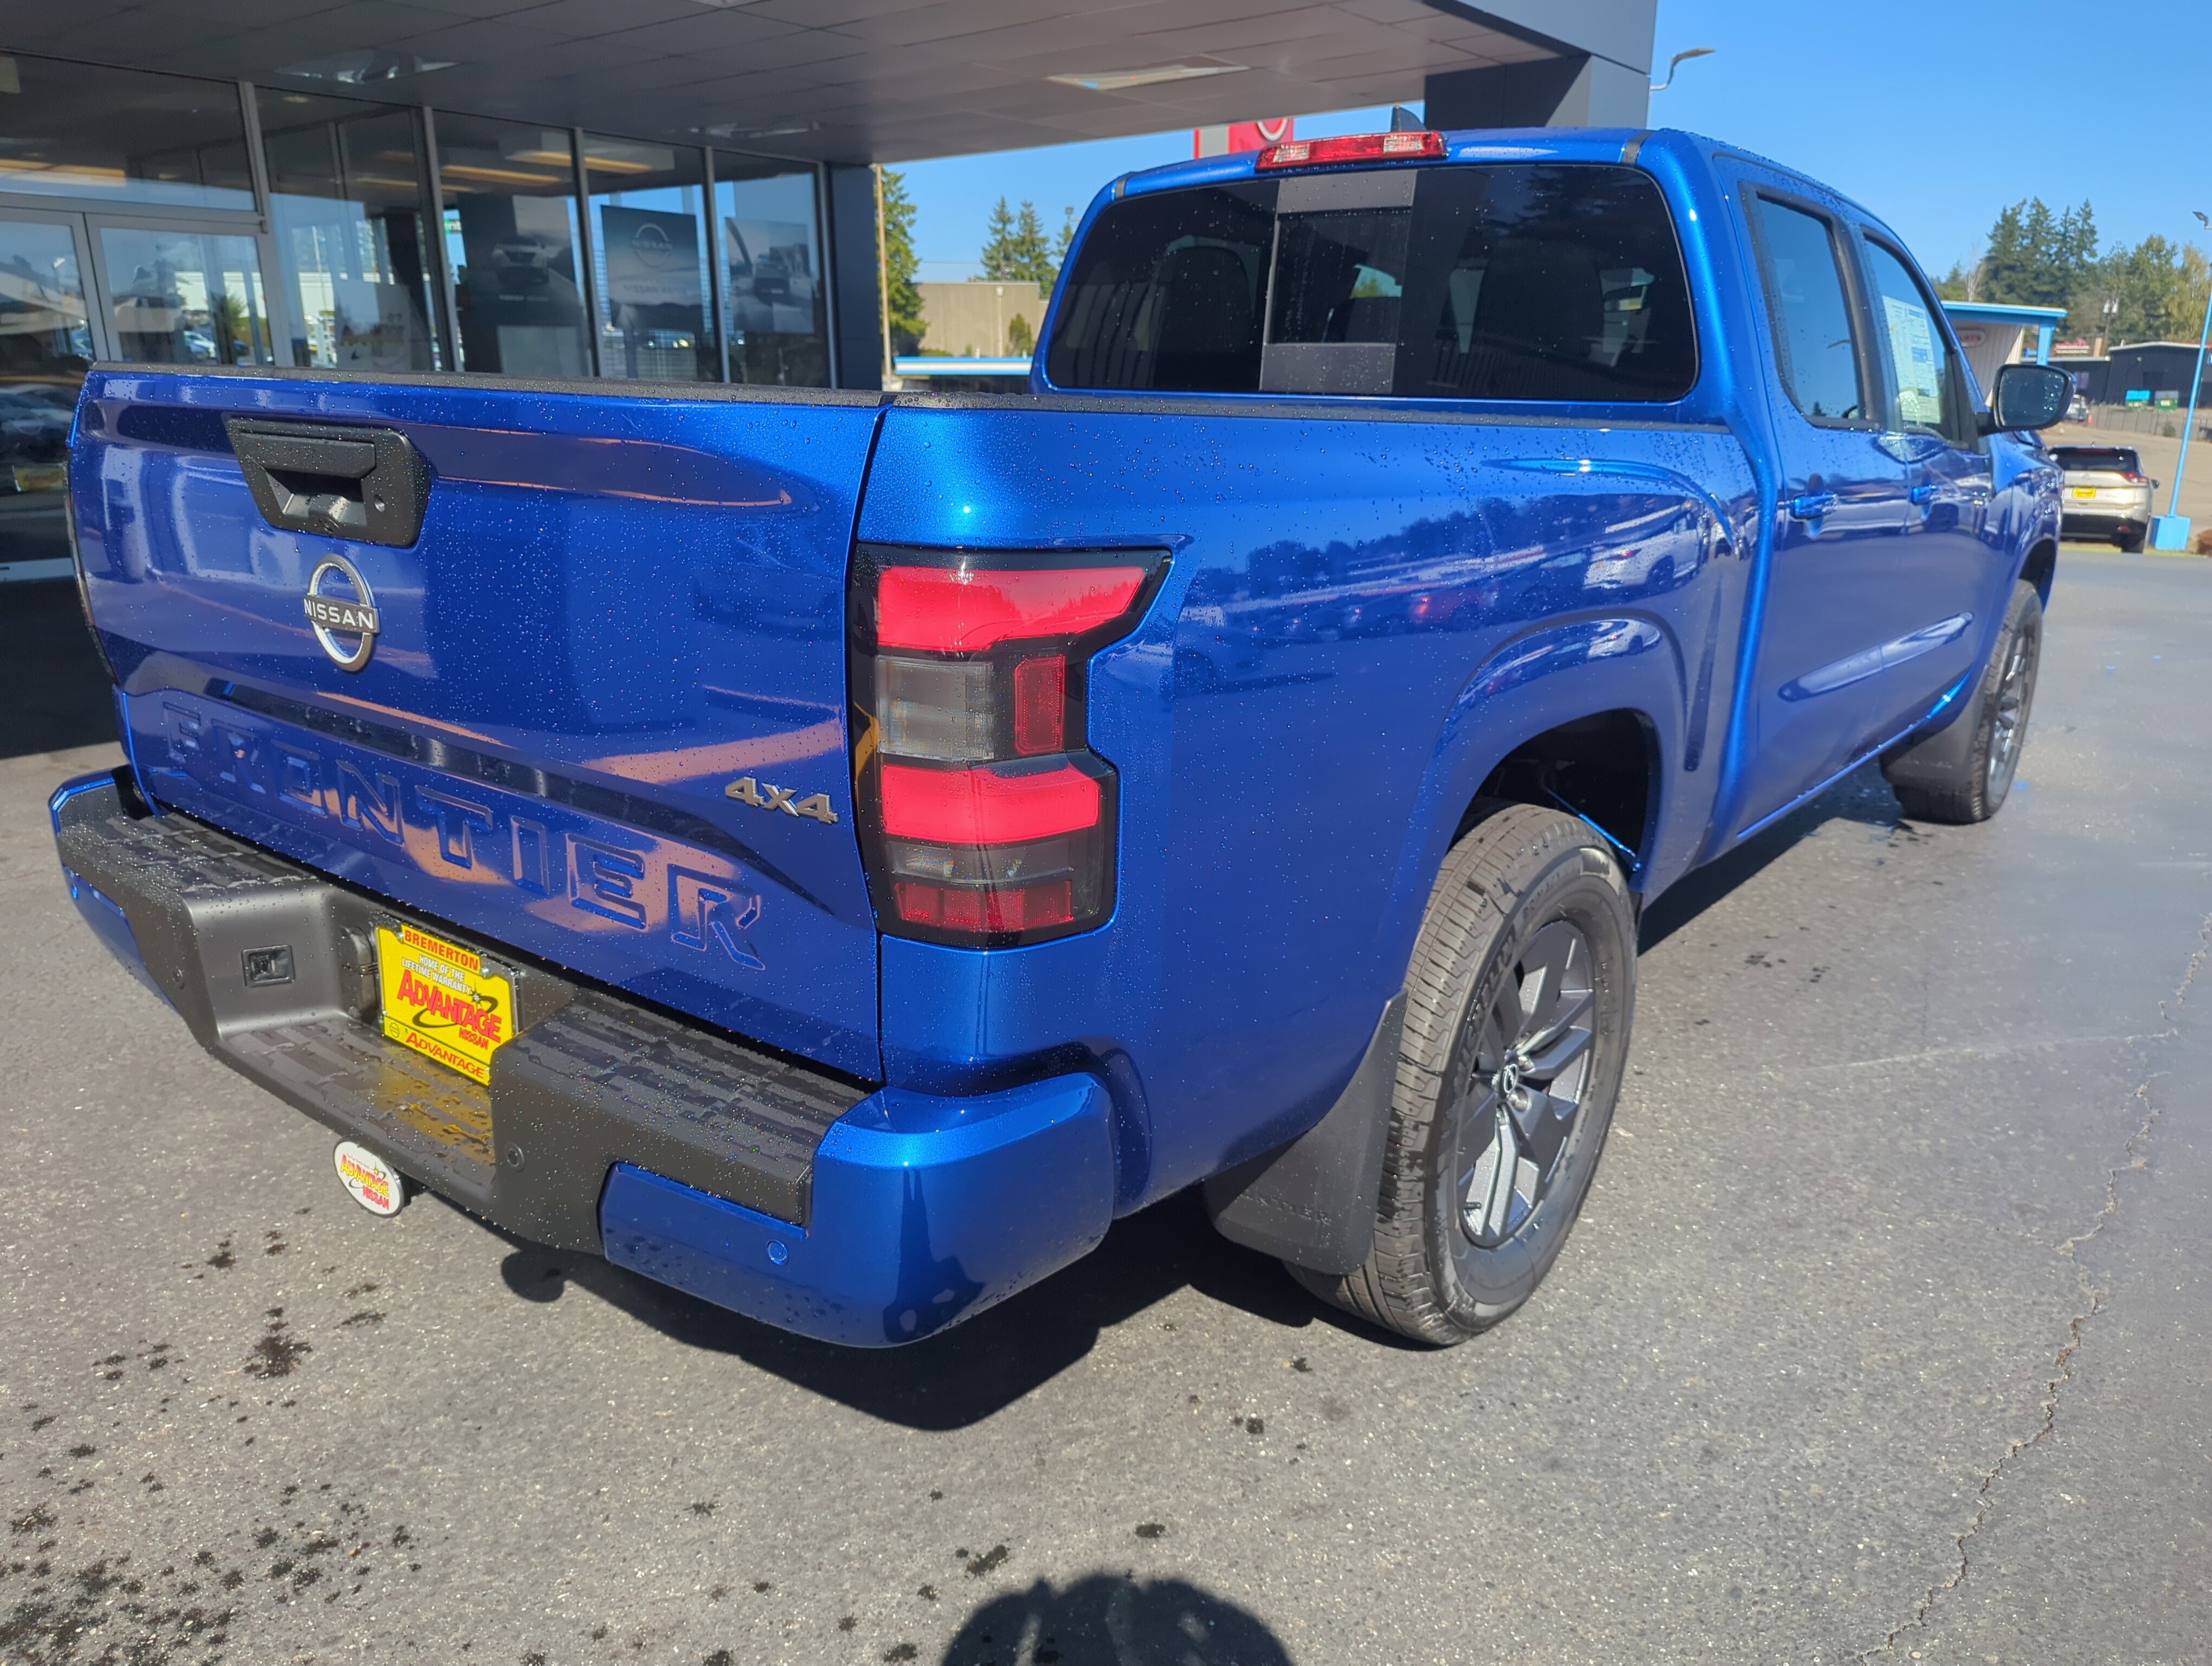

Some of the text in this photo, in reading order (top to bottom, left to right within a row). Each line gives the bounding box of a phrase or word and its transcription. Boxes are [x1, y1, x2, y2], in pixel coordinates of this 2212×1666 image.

[304, 598, 374, 630] NISSAN
[163, 701, 765, 970] FRONTIER
[404, 929, 479, 971] BREMERTON
[419, 954, 465, 982] HOME OF THE
[402, 957, 472, 995] LIFETIME WARRANTY
[397, 969, 501, 1043] ADVANTAGE
[406, 1032, 485, 1079] ADVANTAGE
[459, 1027, 488, 1050] NISSAN
[340, 1154, 389, 1197] ADVANTAGE
[363, 1184, 389, 1210] NISSAN
